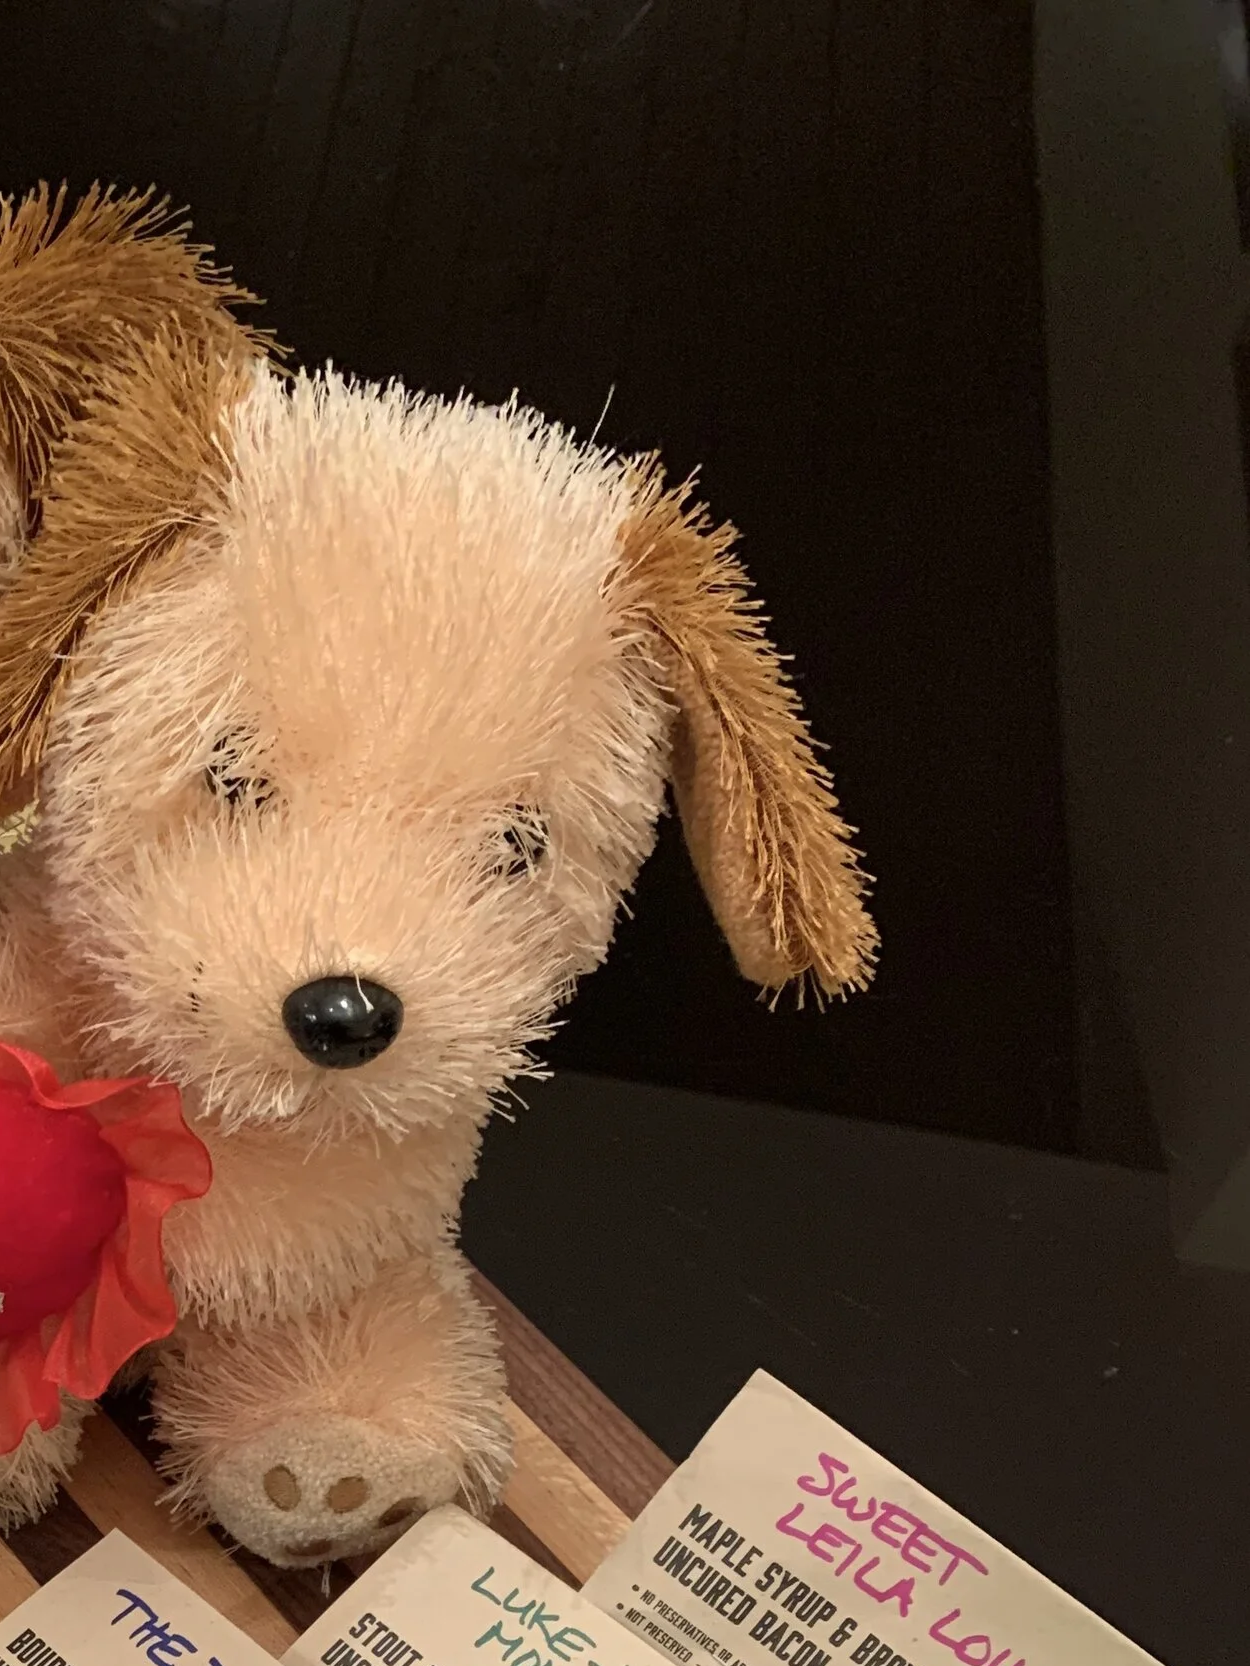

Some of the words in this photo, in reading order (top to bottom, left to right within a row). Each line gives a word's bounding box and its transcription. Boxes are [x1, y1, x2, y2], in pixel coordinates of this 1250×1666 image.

[775, 1502, 917, 1618] LEILA
[796, 1452, 990, 1587] SWEET
[639, 1589, 655, 1605] NO
[652, 1599, 720, 1655] PRESERVATIVES
[717, 1648, 733, 1663] OR
[652, 1535, 757, 1625] UNCURED
[677, 1503, 764, 1577] MAPLE
[754, 1561, 837, 1628] SYRUP
[828, 1617, 858, 1647] &
[624, 1607, 646, 1626] NOT
[642, 1621, 693, 1663] PRESERVED
